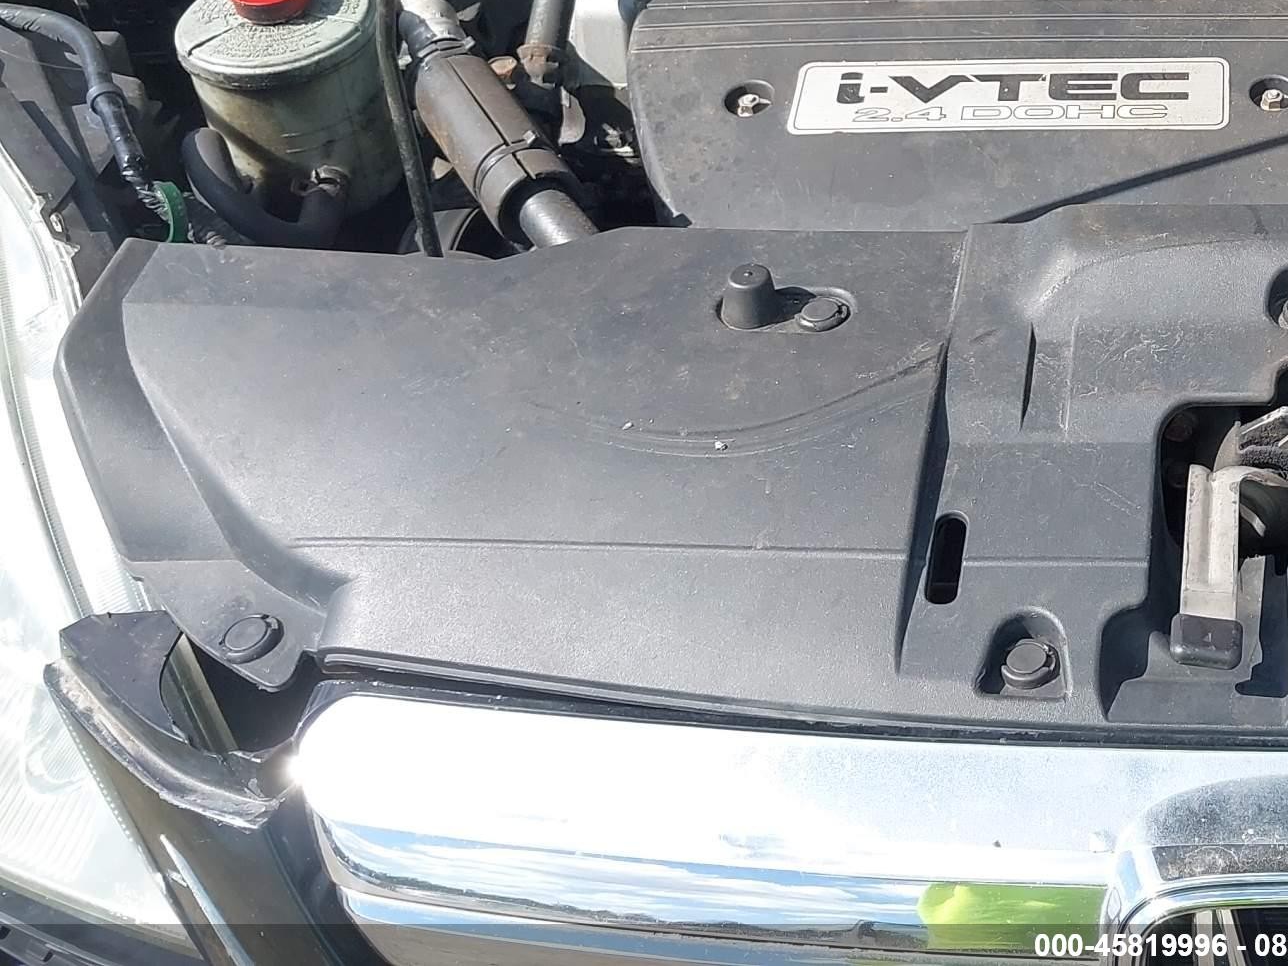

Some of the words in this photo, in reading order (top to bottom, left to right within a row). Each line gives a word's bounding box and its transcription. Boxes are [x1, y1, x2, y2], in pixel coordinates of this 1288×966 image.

[837, 72, 1190, 104] i-VTEC
[852, 106, 947, 123] 2.4
[960, 104, 1169, 121] DOHC
